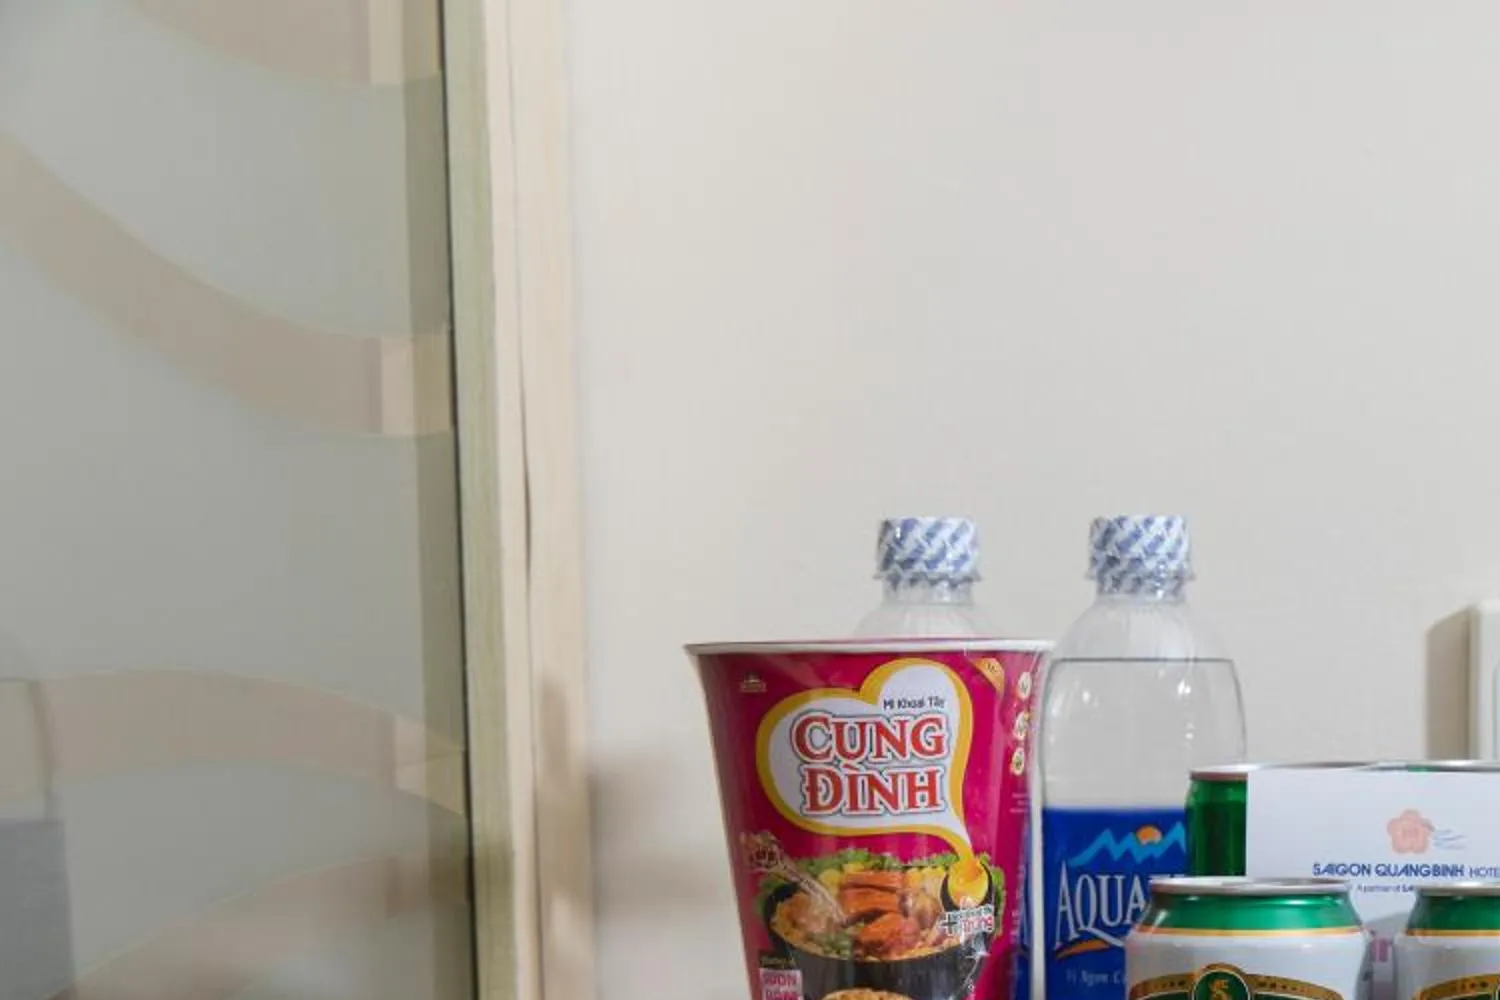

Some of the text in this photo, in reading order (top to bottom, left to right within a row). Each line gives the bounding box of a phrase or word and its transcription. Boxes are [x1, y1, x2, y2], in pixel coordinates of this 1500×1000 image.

[793, 714, 946, 761] CUNG
[804, 757, 943, 812] ĐÌNH
[1312, 863, 1371, 878] SAIGON
[1054, 859, 1185, 948] AQUA
